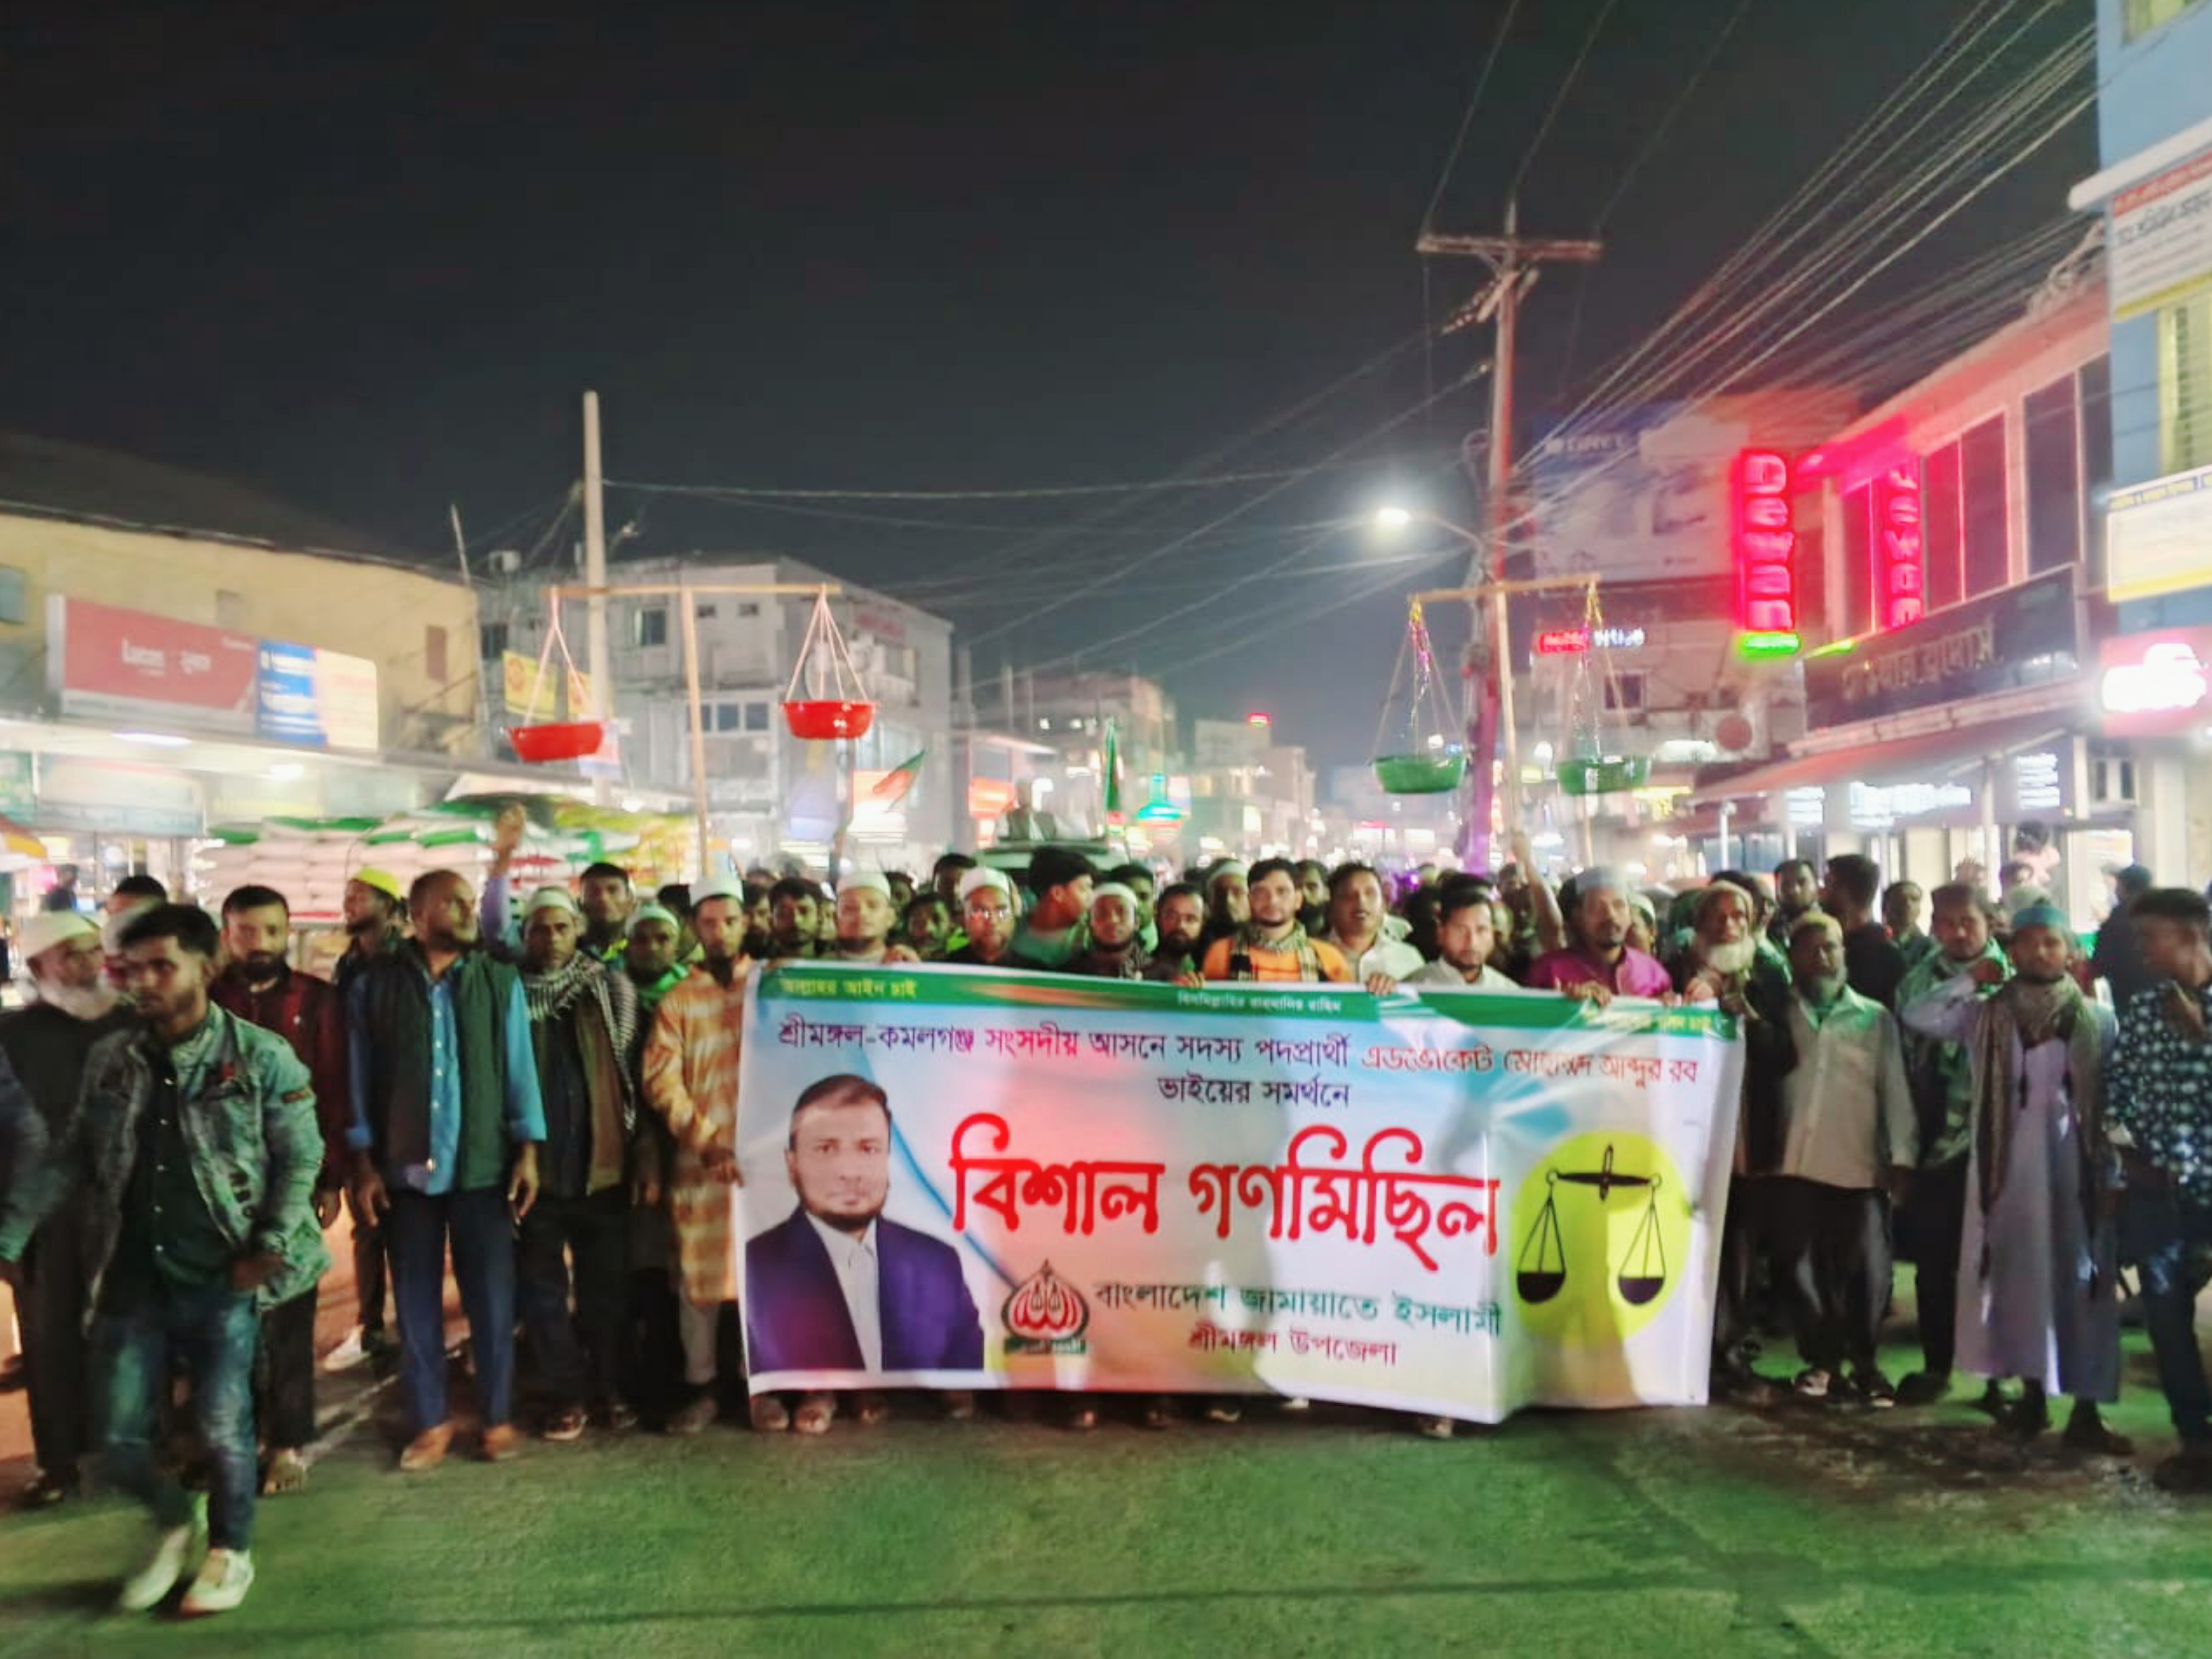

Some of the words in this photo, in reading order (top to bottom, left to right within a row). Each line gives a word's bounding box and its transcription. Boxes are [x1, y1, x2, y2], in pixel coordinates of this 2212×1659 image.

[985, 1022, 1079, 1058] সংসদীয়
[1088, 1032, 1166, 1062] আসনে
[1176, 1035, 1242, 1064] সদস্য
[1255, 1031, 1352, 1067] পদপ্রার্থী
[1362, 1043, 1494, 1074] এডভোকেট
[1599, 1054, 1662, 1090] আব্দুর
[1668, 1058, 1699, 1084] রব
[1158, 1073, 1251, 1104] ভাইয়ের
[1261, 1076, 1351, 1108] সমর্থনে
[949, 1113, 1165, 1235] বিশাল
[1189, 1125, 1500, 1271] গণমিছিল
[1094, 1281, 1227, 1312] বাংলাদেশ
[1239, 1287, 1379, 1321] জামায়াতে
[1393, 1289, 1503, 1340] ইসলামী
[1189, 1321, 1278, 1355] শ্রীমঙ্গল
[1291, 1327, 1398, 1367] উপজেলা
